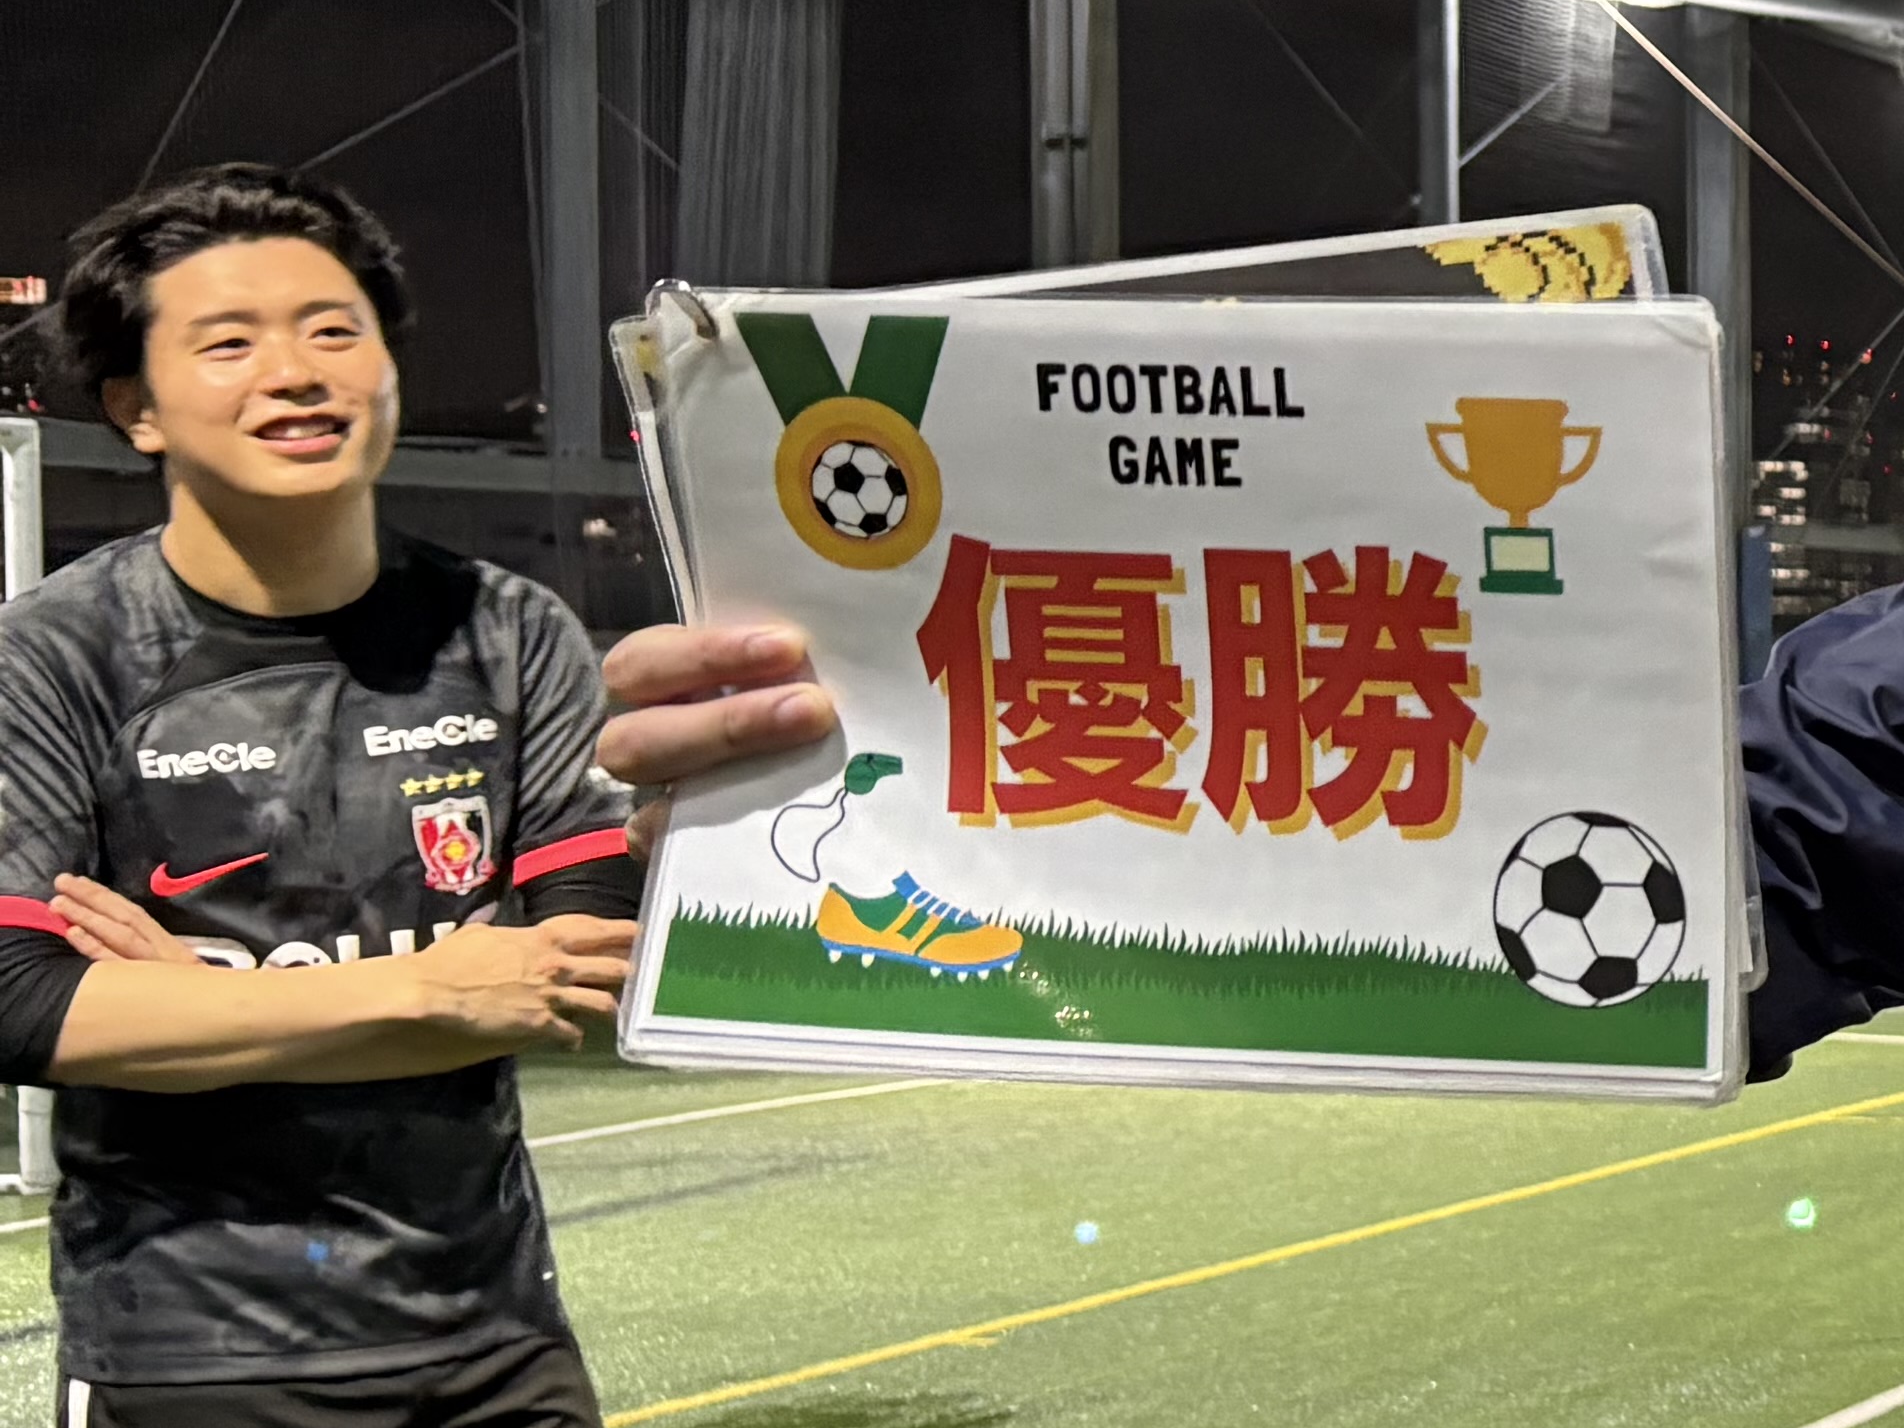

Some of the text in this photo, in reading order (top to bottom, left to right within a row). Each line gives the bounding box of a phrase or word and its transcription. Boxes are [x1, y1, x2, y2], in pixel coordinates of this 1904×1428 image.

[1036, 362, 1305, 418] FOOTBALL
[1108, 435, 1243, 487] GAME
[915, 533, 1488, 841] 優勝
[136, 742, 277, 779] EneCle
[363, 713, 499, 757] EneCle
